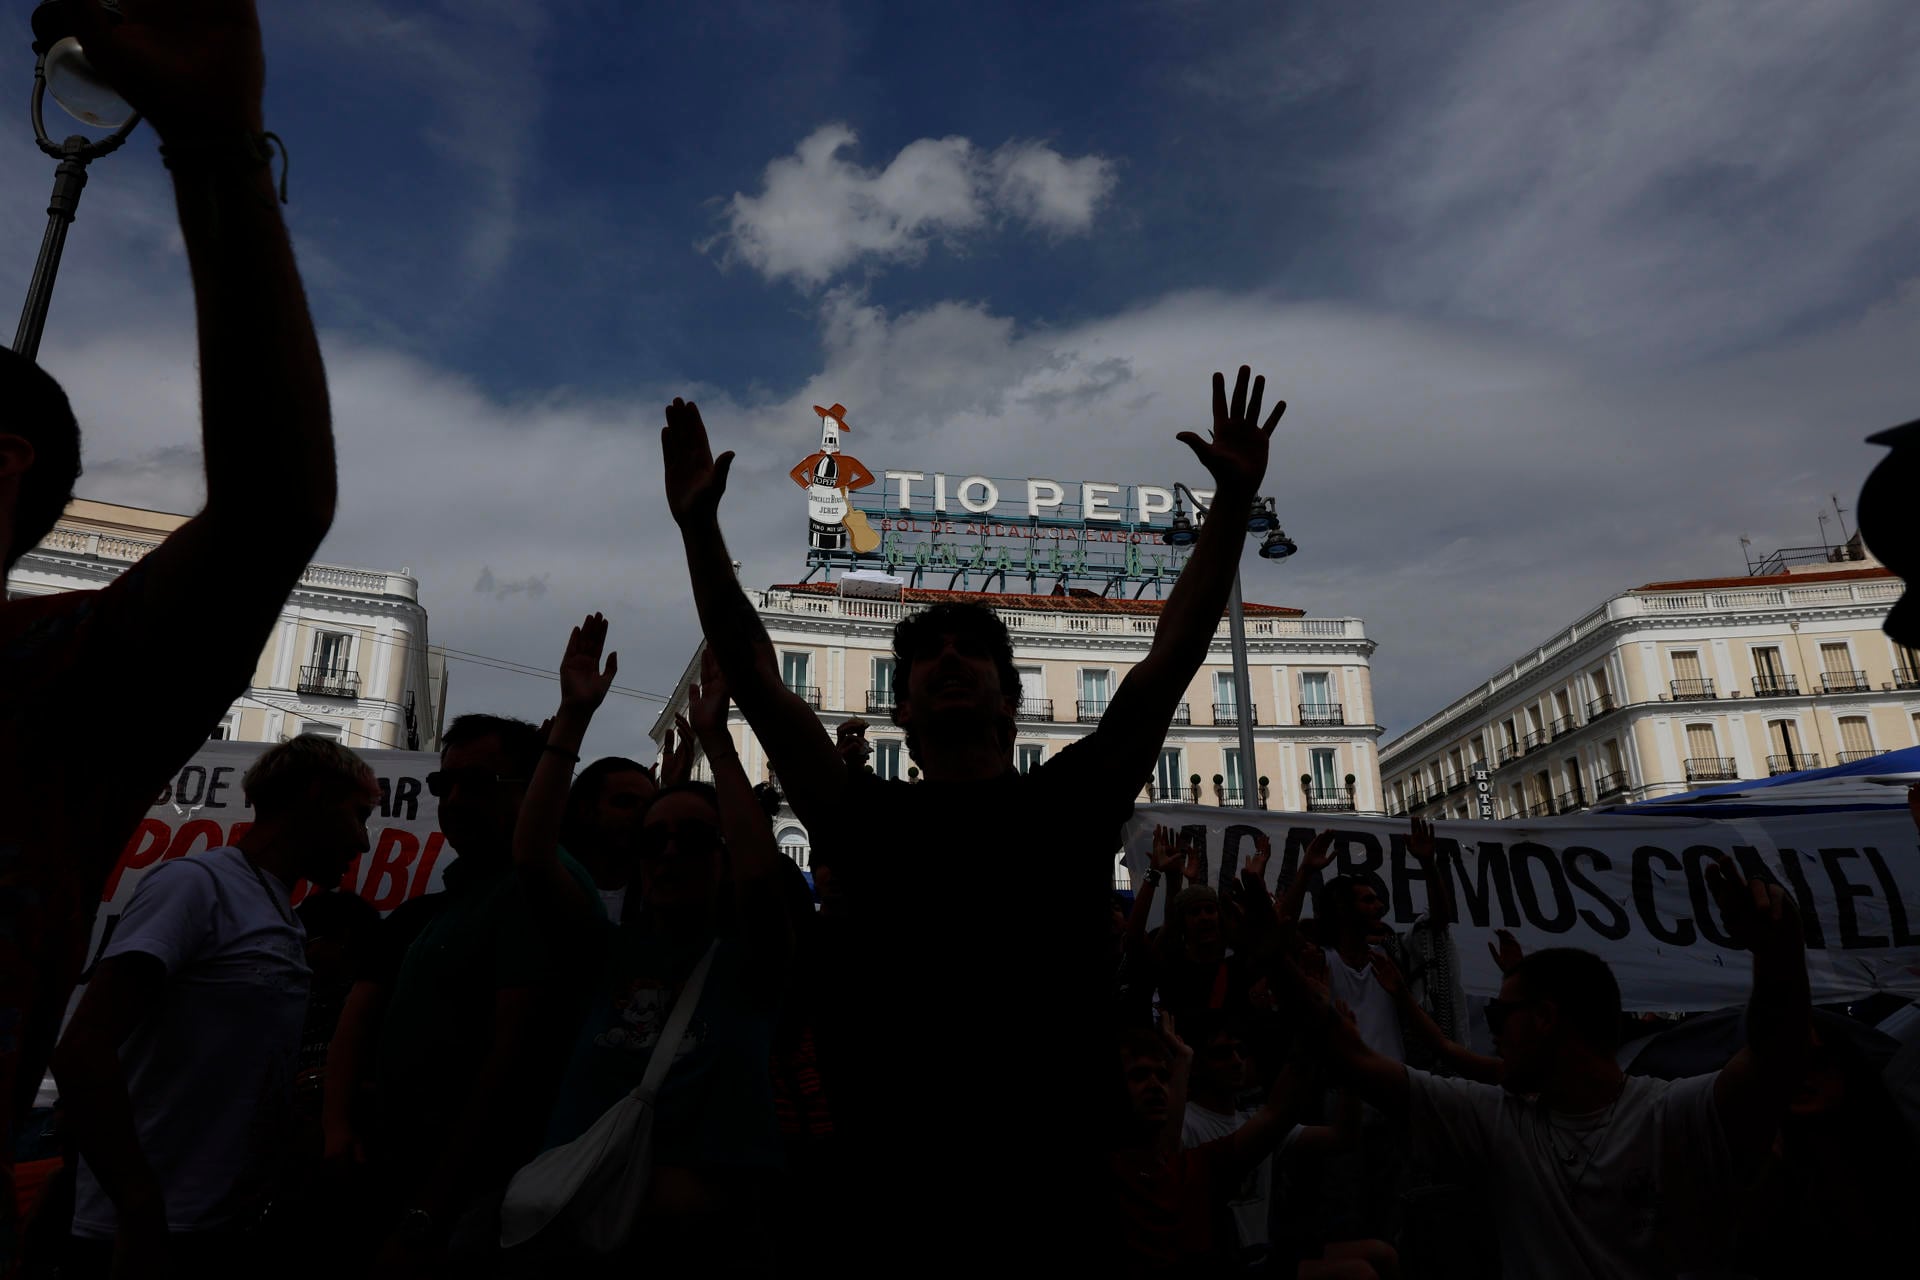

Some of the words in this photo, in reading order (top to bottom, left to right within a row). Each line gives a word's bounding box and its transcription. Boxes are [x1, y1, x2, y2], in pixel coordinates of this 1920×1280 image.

[819, 506, 838, 514] JEREZ
[885, 470, 999, 513] TIO
[881, 518, 923, 533] SOL
[931, 520, 956, 534] DE
[966, 523, 1078, 541] ANDALUCIA
[887, 533, 1088, 573] GONZALEZ
[1474, 770, 1491, 820] HOTE
[1818, 847, 1920, 949] EL
